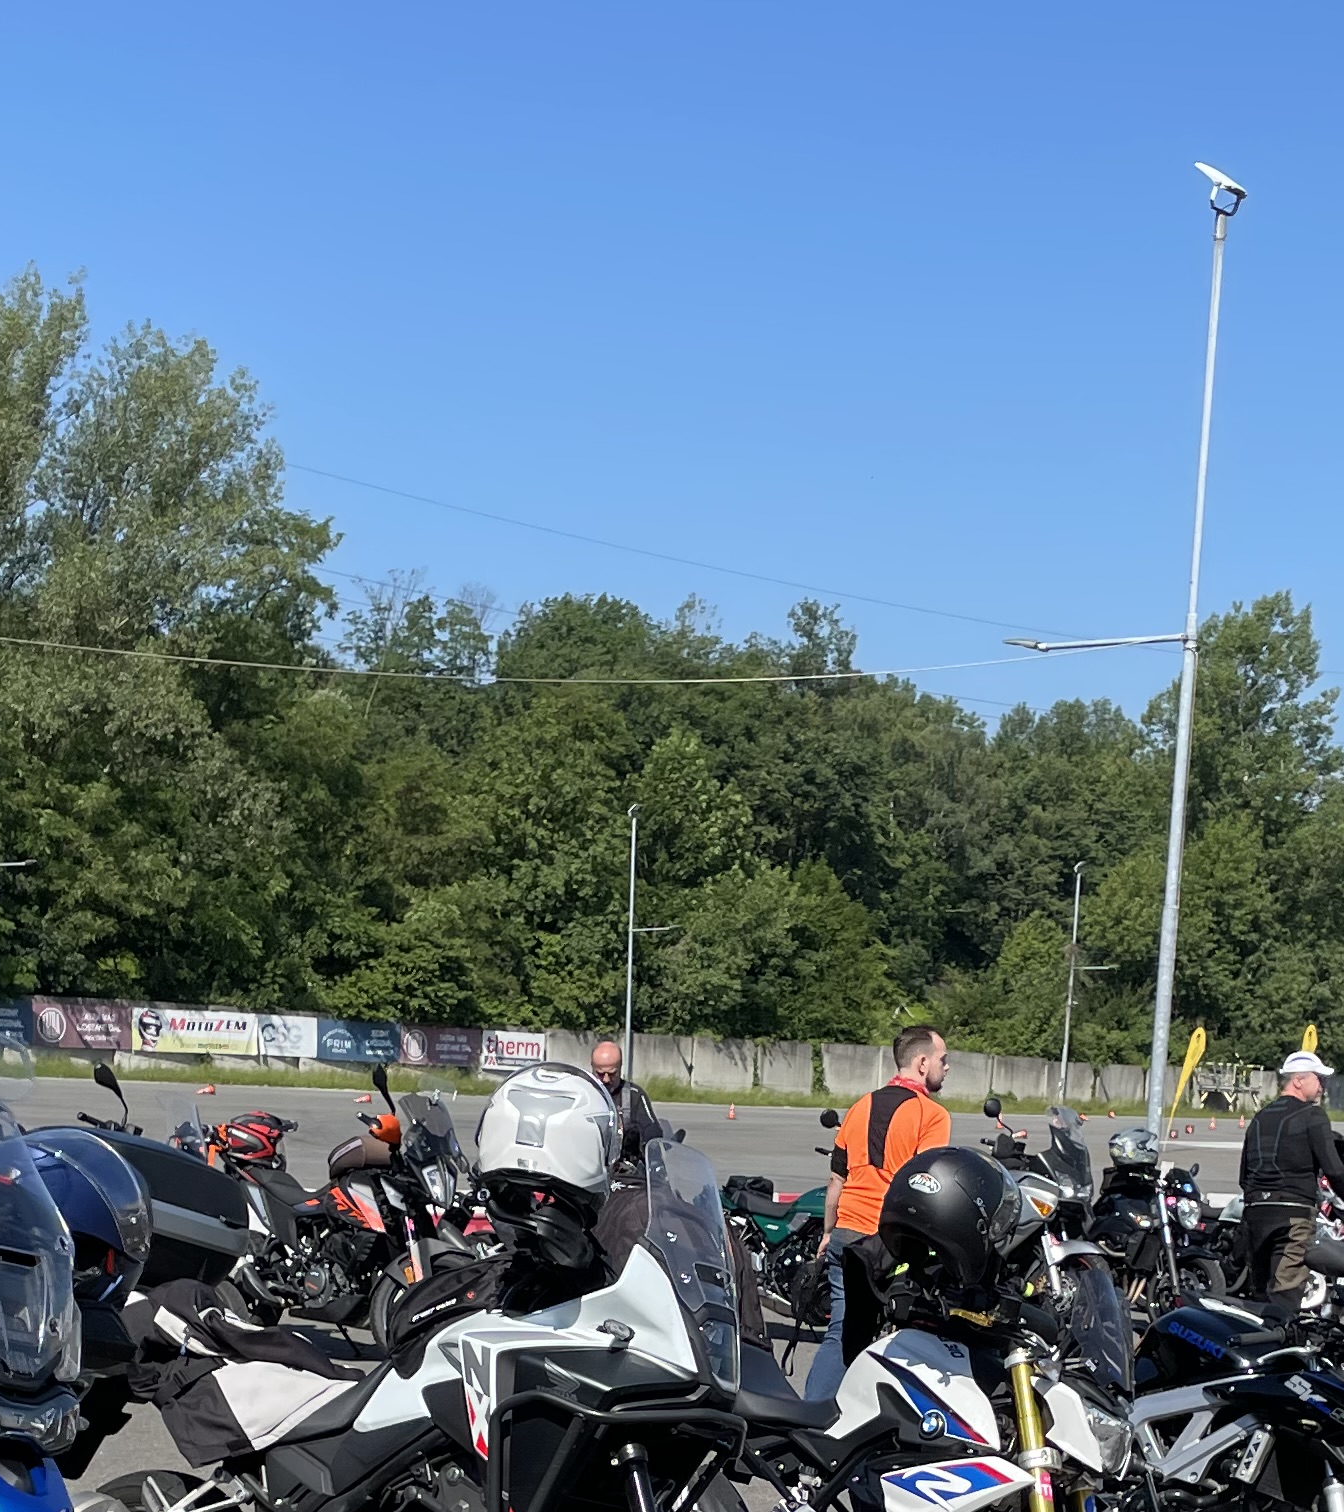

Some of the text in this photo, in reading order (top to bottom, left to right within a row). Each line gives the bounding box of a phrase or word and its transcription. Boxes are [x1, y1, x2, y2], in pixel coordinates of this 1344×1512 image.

[326, 1038, 352, 1049] PRIM
[486, 1034, 541, 1057] therm
[1167, 1320, 1227, 1360] SUZUKI
